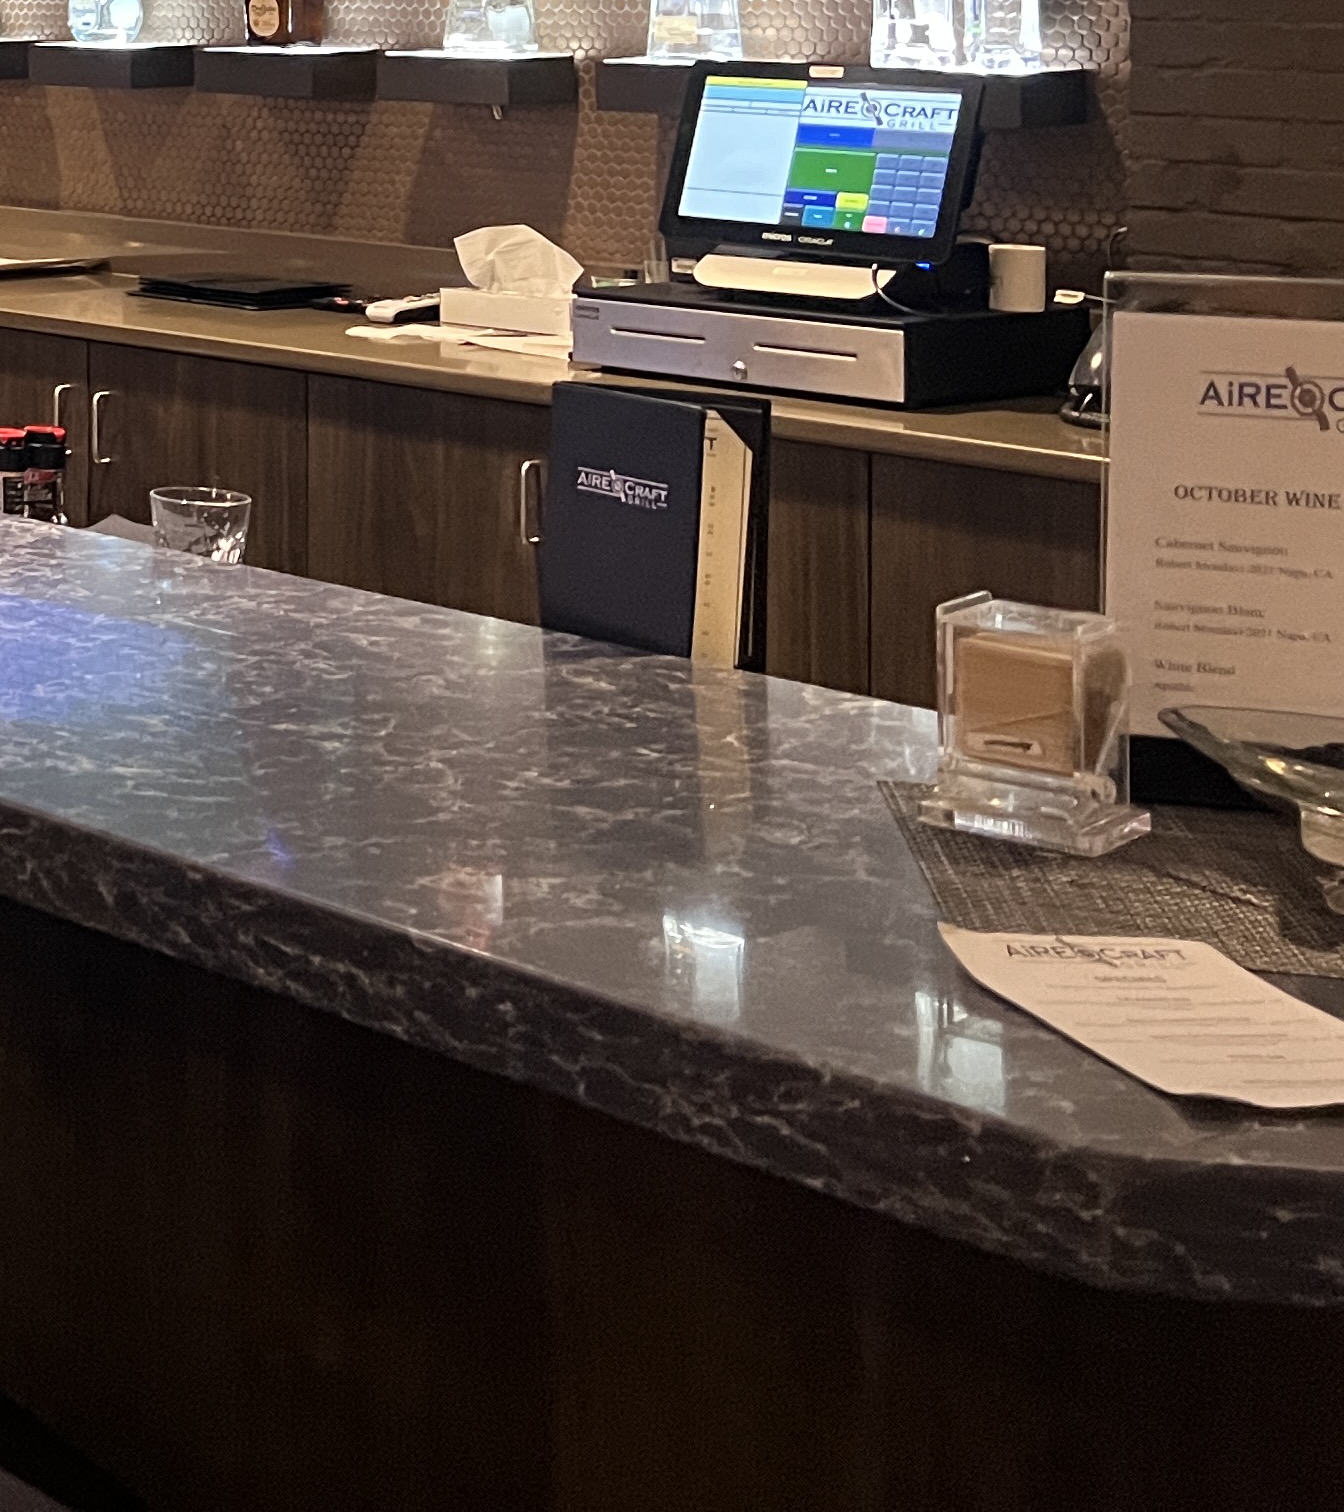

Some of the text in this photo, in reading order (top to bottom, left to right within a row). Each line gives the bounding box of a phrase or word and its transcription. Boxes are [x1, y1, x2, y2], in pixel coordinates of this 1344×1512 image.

[886, 118, 936, 131] GRILL
[624, 481, 668, 502] CRAFT
[1174, 484, 1341, 510] OCTOBER WINE
[1154, 659, 1236, 675] White Blend
